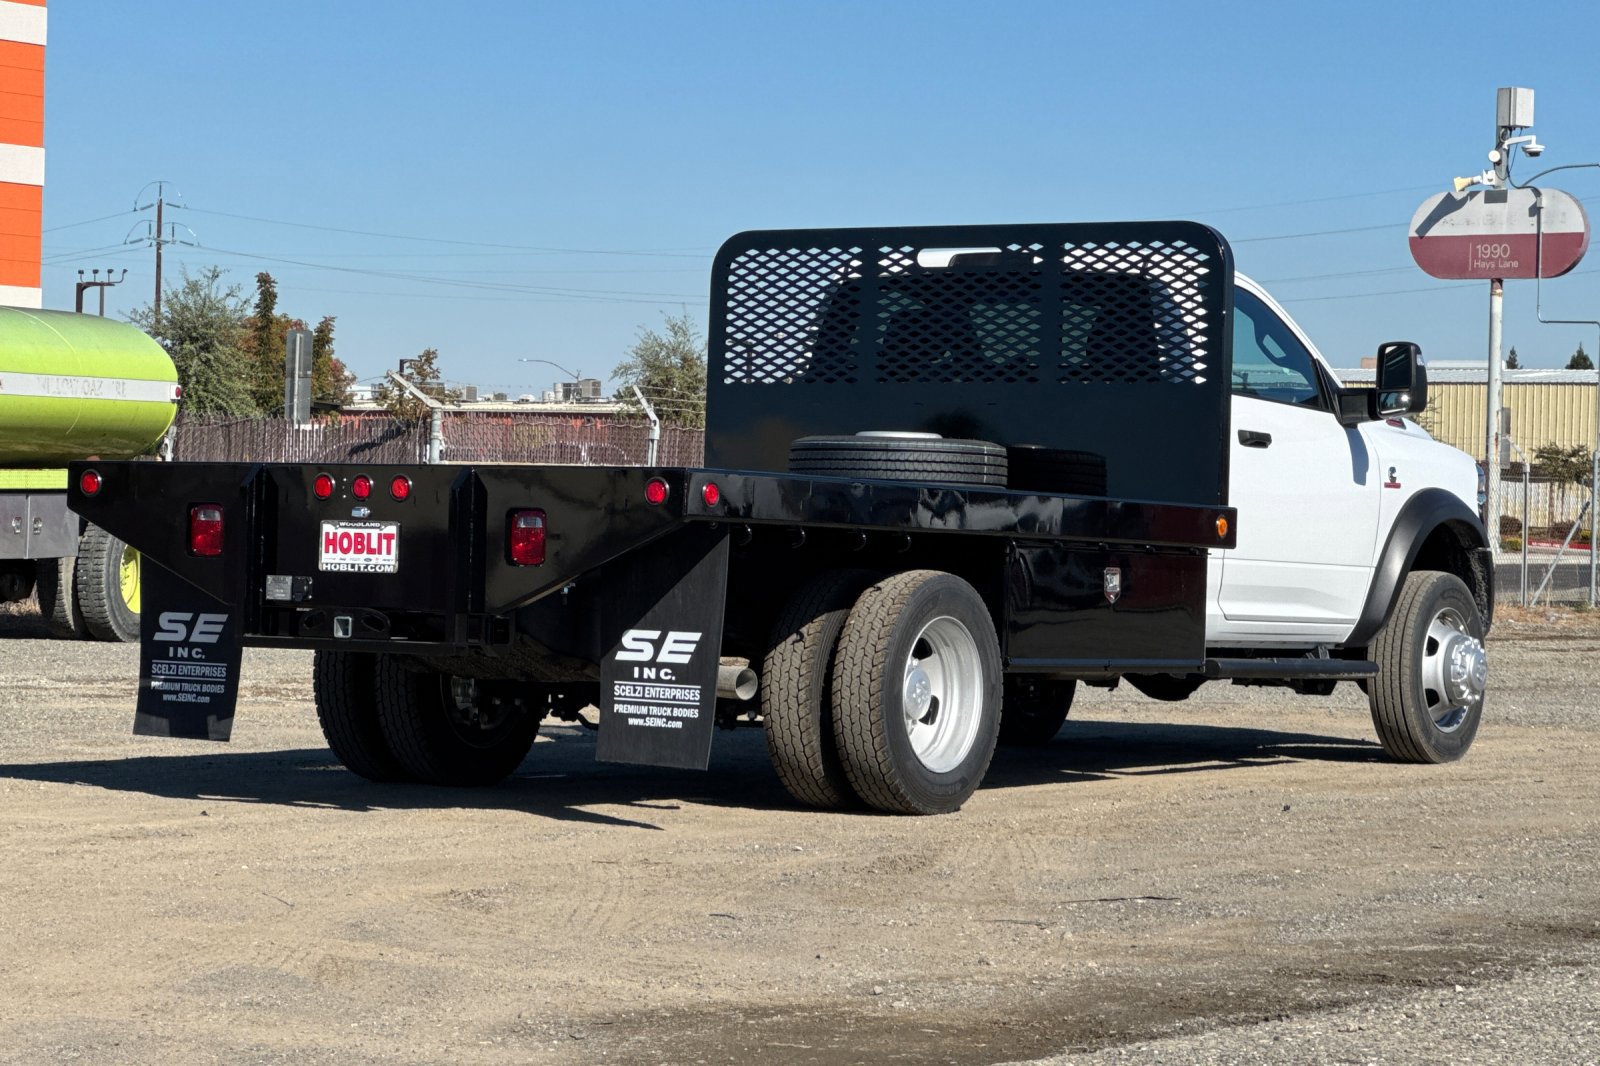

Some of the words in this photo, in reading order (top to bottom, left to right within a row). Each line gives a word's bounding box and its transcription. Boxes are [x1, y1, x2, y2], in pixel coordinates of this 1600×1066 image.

[1476, 243, 1511, 259] 1990
[1473, 259, 1496, 270] Hays
[1498, 258, 1519, 268] Lane
[324, 531, 396, 556] HOBLIT
[322, 563, 394, 573] HOBLIT.COM
[152, 611, 229, 644] SE
[168, 646, 206, 659] INC.
[614, 629, 703, 664] SE
[151, 663, 177, 675] SCELZI
[177, 664, 227, 678] ENTERPRISES
[633, 666, 676, 681] INC.
[150, 681, 181, 691] PREMIUM
[181, 682, 202, 693] TRUCK
[201, 684, 225, 694] BODIES
[613, 684, 643, 698] SCELZI
[644, 686, 700, 701] ENTERPRISES
[162, 693, 210, 703] www.SEINC.com
[613, 703, 649, 716] PREMIUM
[649, 705, 673, 717] TRUCK
[672, 708, 699, 718] BODIES
[627, 716, 683, 729] www.SEINC.com
